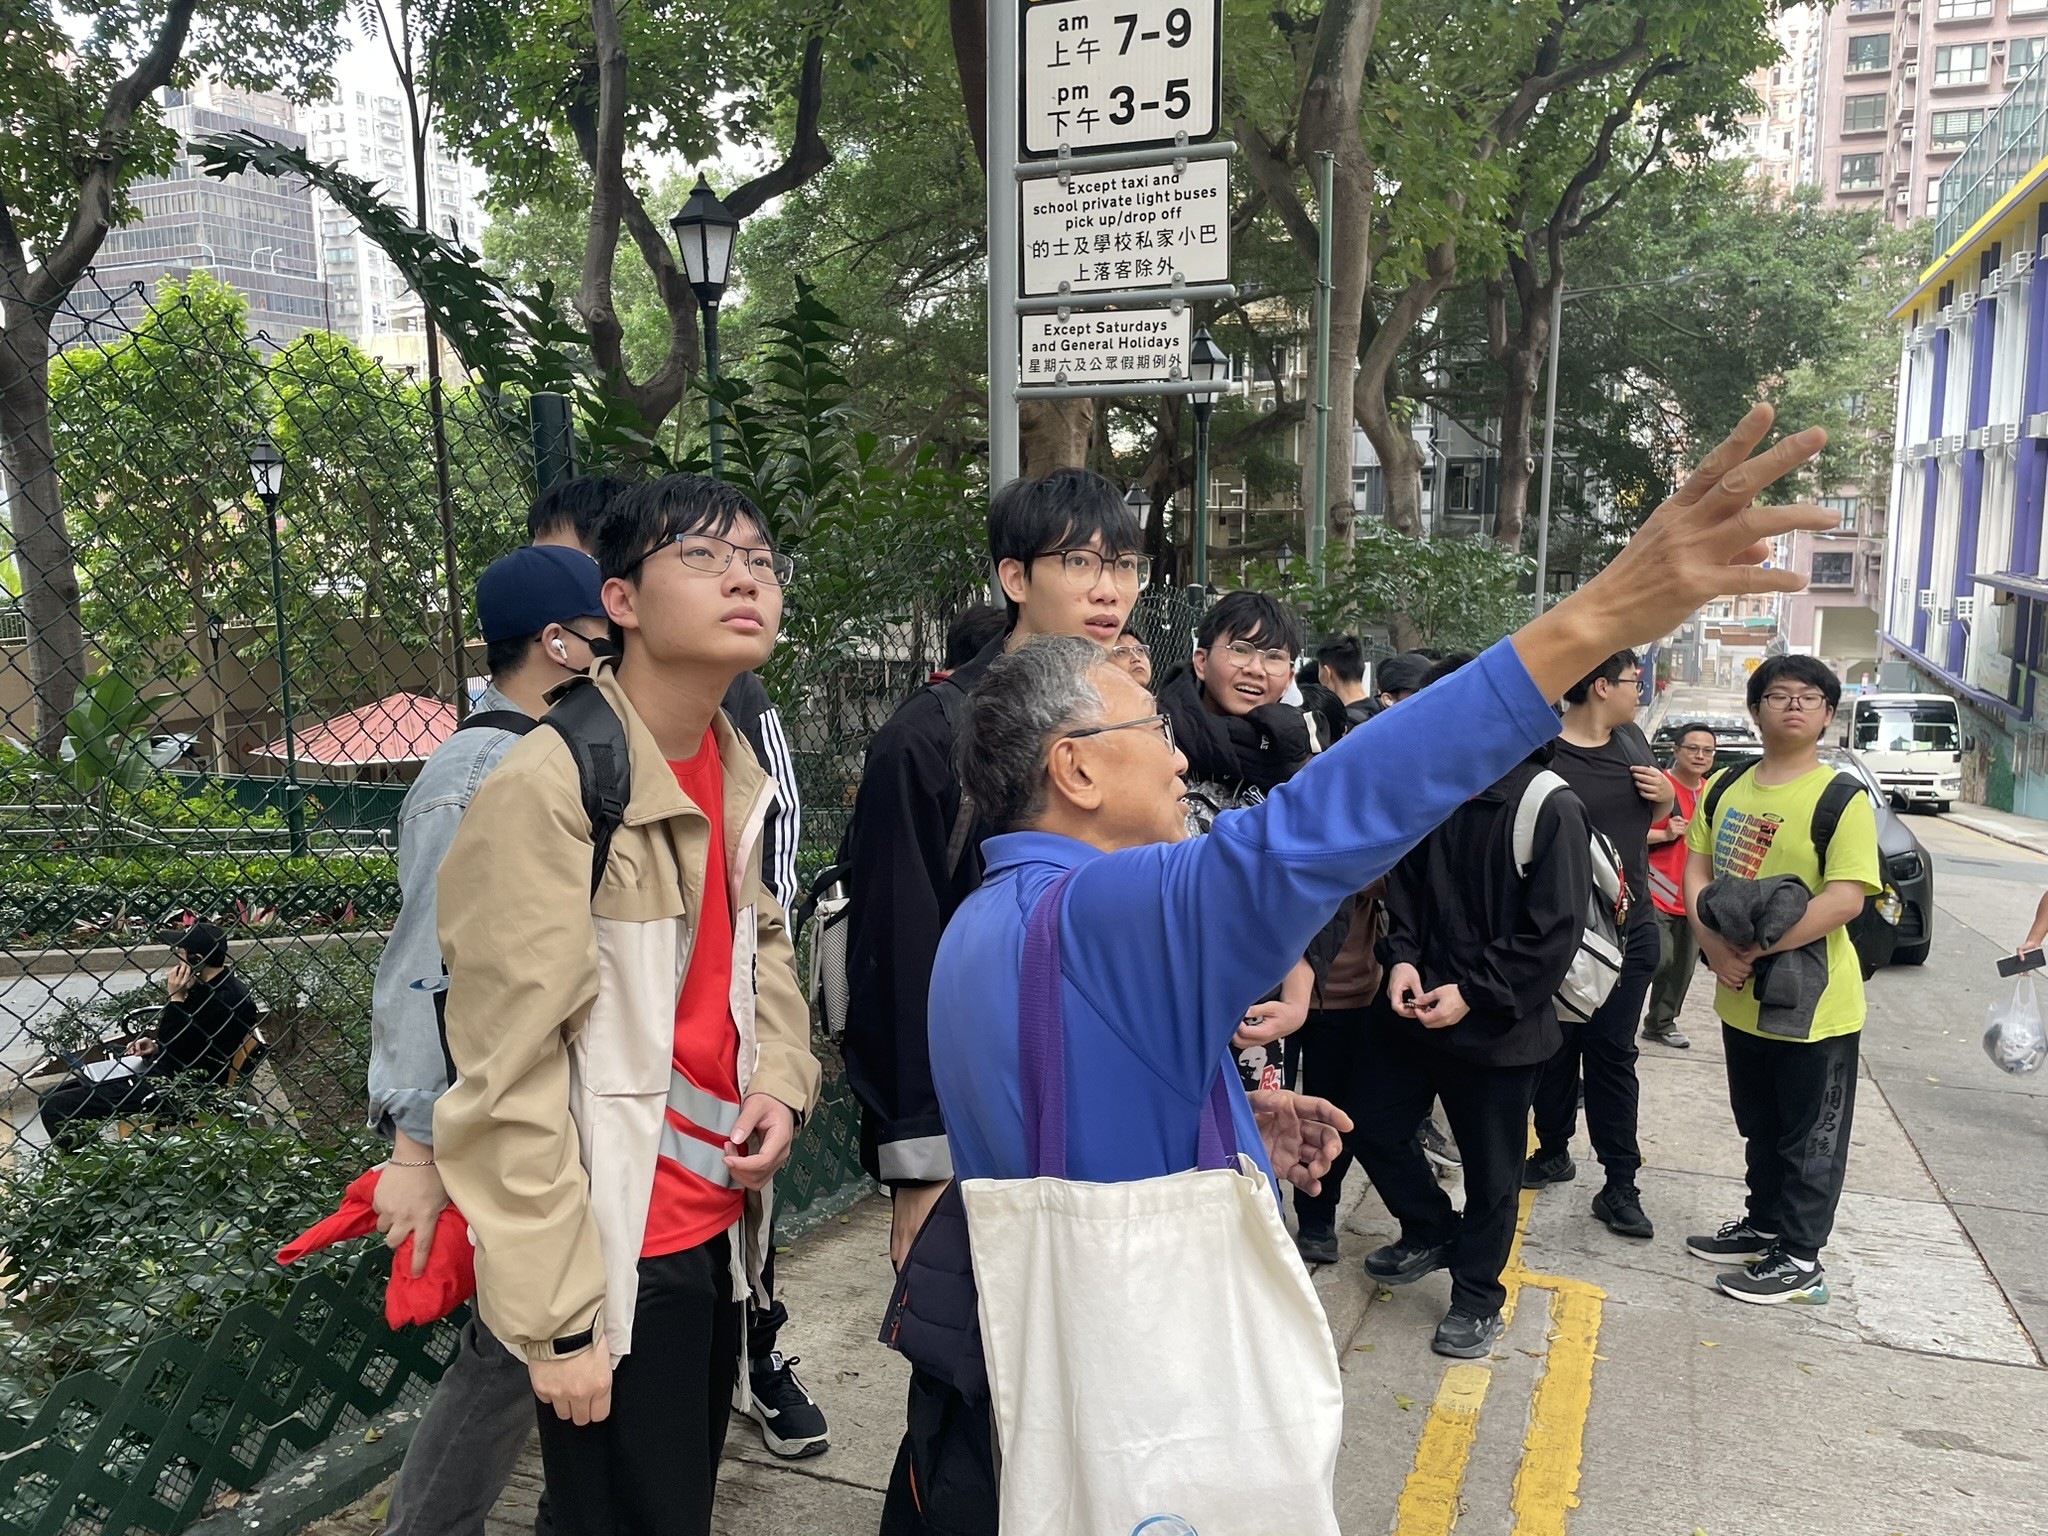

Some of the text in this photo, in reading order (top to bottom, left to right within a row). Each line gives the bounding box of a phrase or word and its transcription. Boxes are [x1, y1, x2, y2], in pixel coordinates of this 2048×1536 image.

[1058, 15, 1089, 32] am
[1047, 37, 1100, 68] 上午
[1057, 84, 1089, 105] pm
[1047, 107, 1100, 137] 下午
[1067, 173, 1180, 195] Except taxi and
[1033, 187, 1217, 215] school private light buses
[1065, 206, 1183, 231] pick up/drop off
[1032, 224, 1218, 260] 的士及學校私家小巴
[1073, 256, 1175, 283] 上落客除外
[1043, 320, 1168, 337] Except Saturdays
[1031, 336, 1180, 352] and General Holidays
[1028, 353, 1182, 374] 星期六及公眾假期例外
[1725, 807, 1746, 822] Keep
[1720, 818, 1741, 834] Keep
[1717, 830, 1768, 858] Keep Running
[1726, 859, 1757, 880] Running
[1731, 847, 1763, 870] Running
